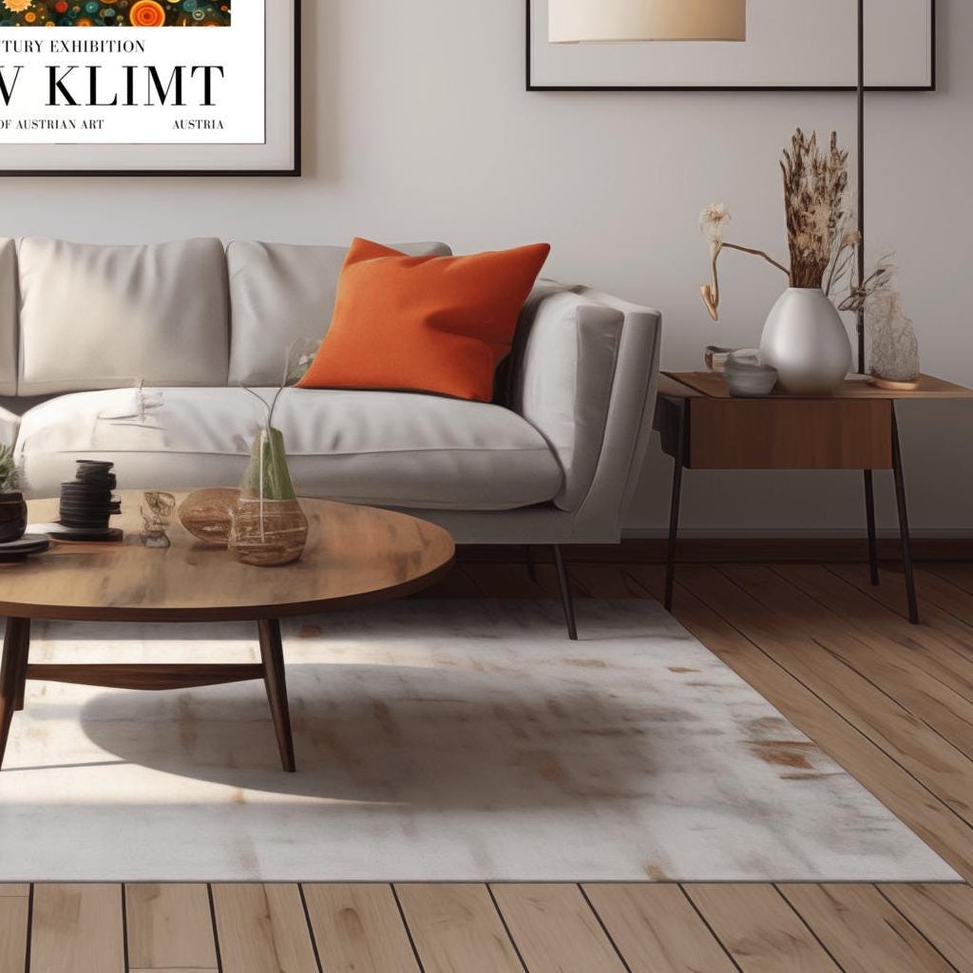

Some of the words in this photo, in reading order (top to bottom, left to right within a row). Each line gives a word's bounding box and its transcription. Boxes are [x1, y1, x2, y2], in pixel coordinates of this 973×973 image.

[49, 40, 145, 53] EXHIBITION
[45, 65, 225, 106] KLIMT
[16, 119, 76, 129] AUSTRIAN
[80, 119, 104, 129] ART
[173, 119, 224, 129] AUSTRIA
